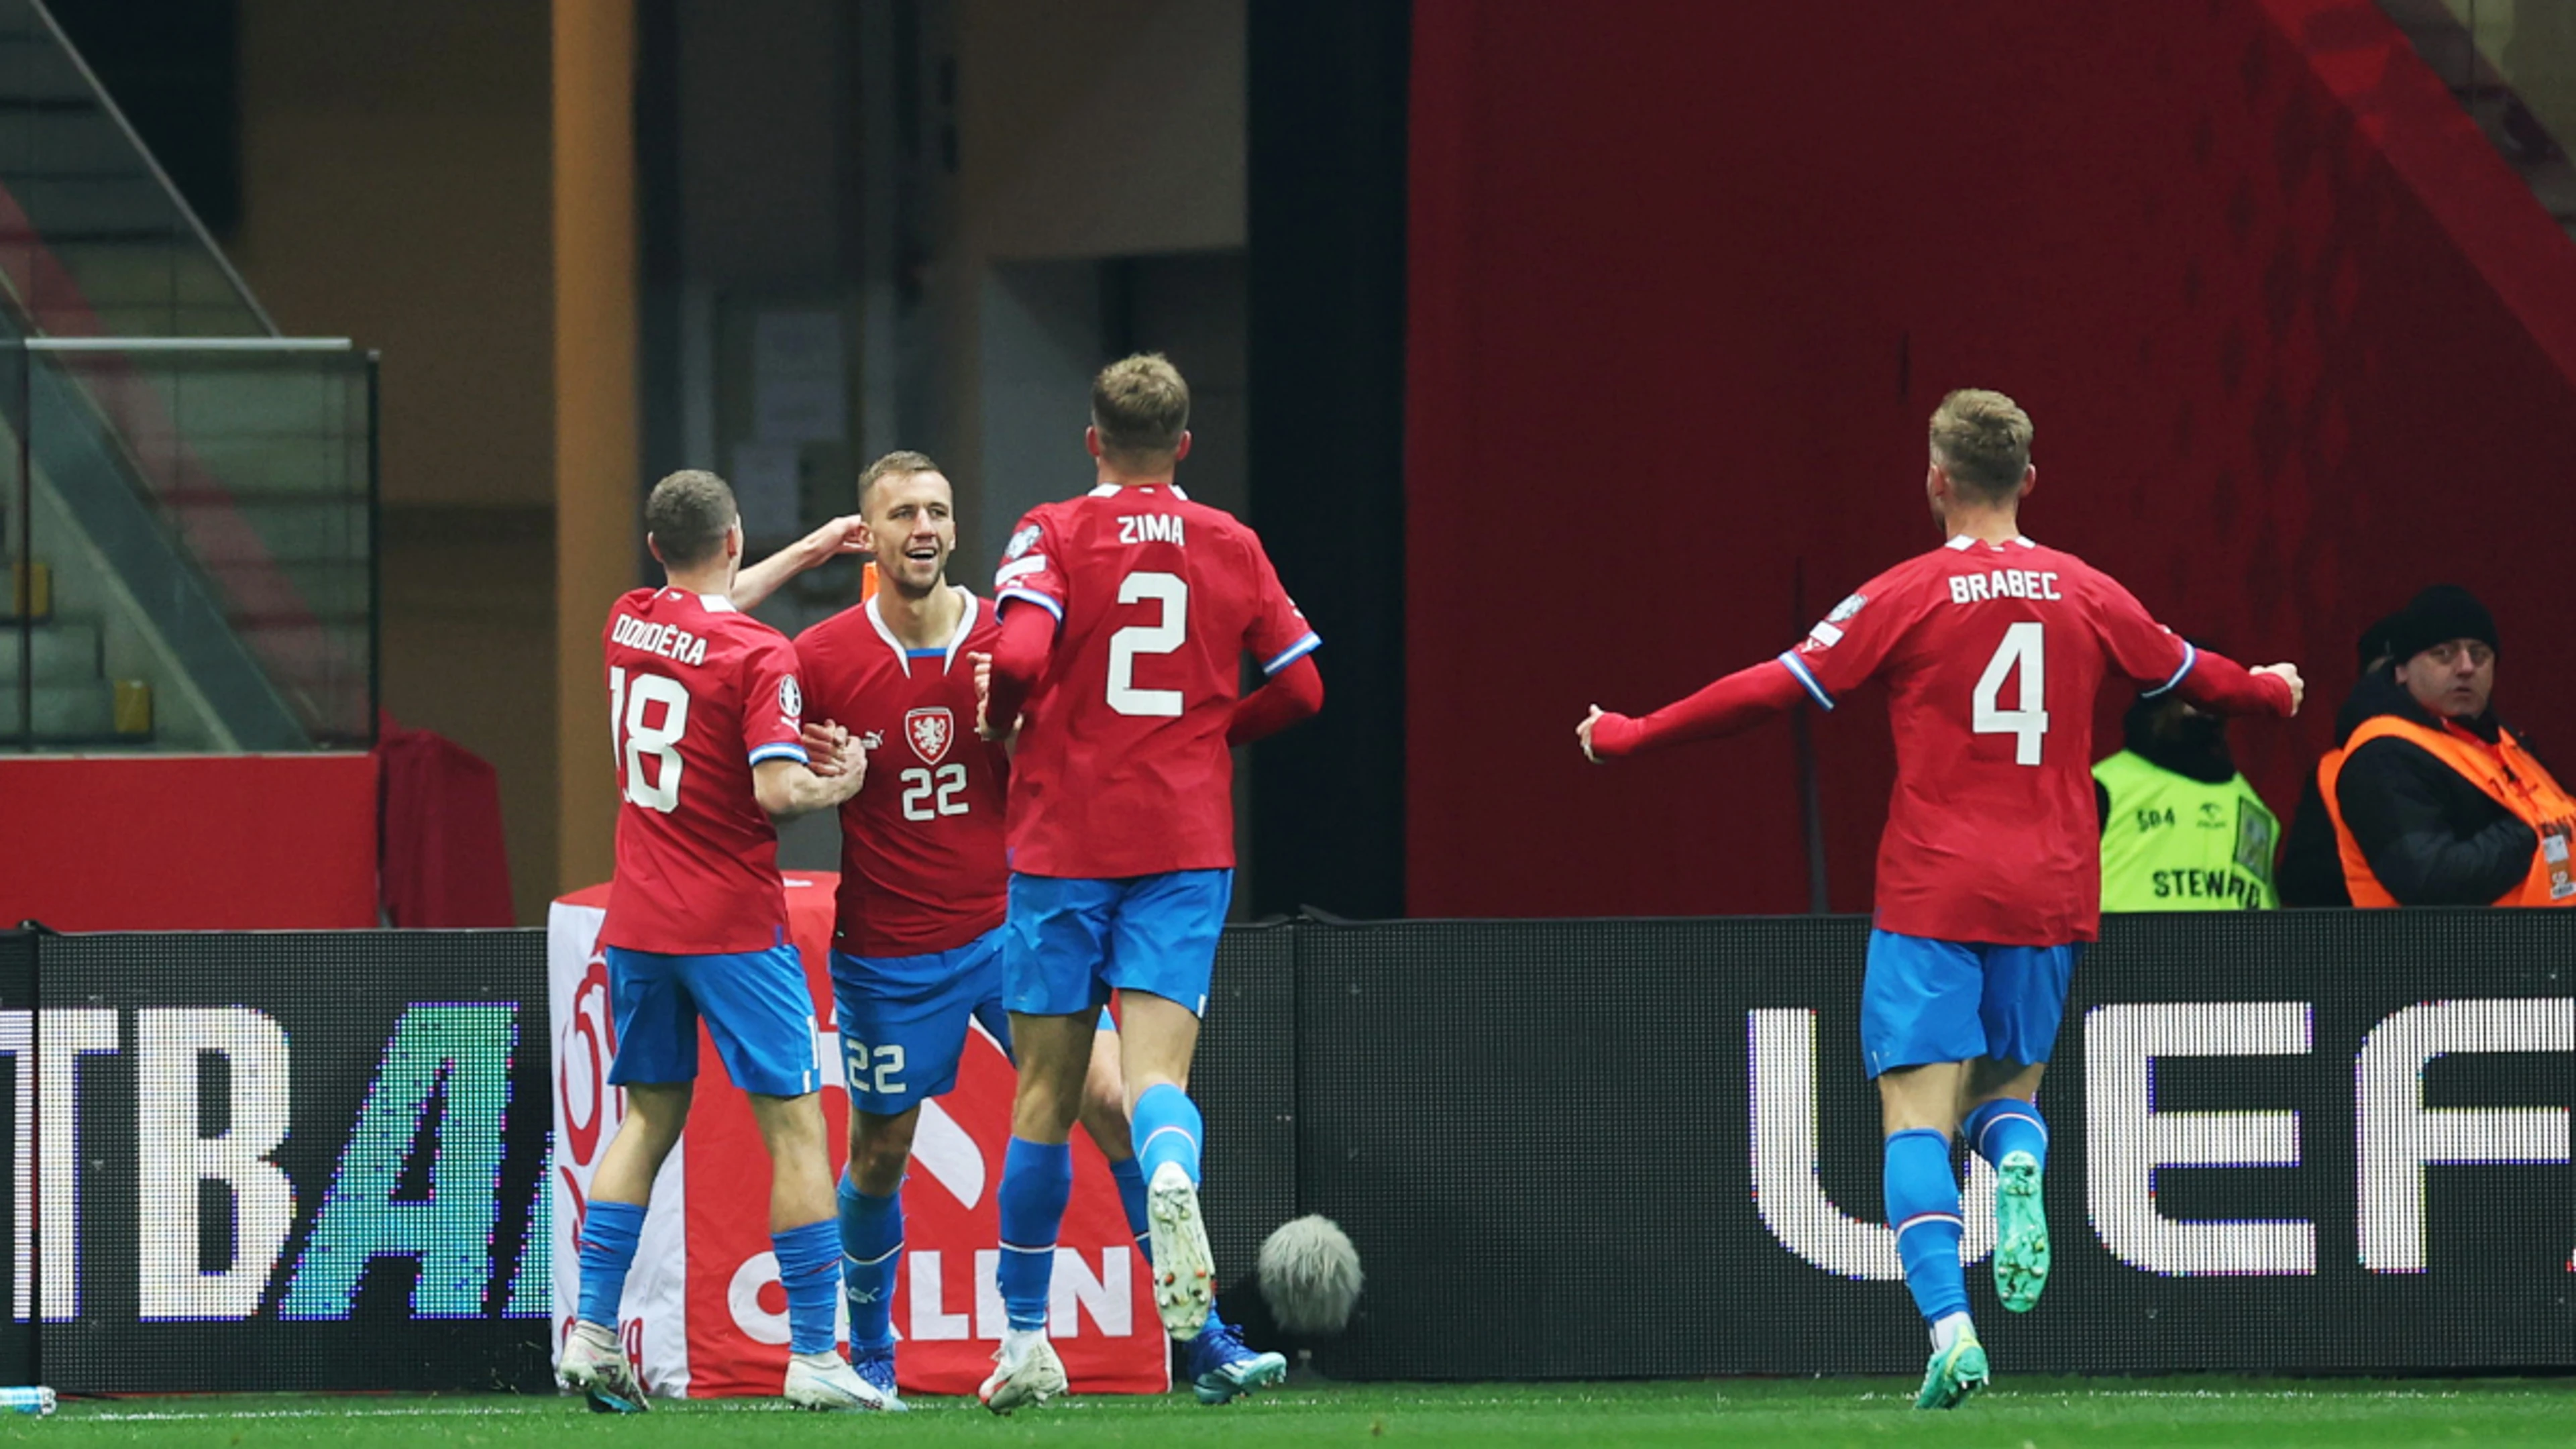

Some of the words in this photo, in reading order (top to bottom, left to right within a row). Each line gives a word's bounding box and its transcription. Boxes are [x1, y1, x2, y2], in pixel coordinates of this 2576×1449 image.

[1117, 514, 1185, 546] ZIMA
[1949, 569, 2061, 604] BRABEC
[1106, 572, 1188, 717] 2
[1972, 622, 2048, 765] 4
[610, 665, 690, 813] 18
[900, 763, 969, 821] 22
[847, 1038, 906, 1093] 22
[1748, 998, 2576, 1280] UEF
[727, 1246, 1132, 1344] OLN
